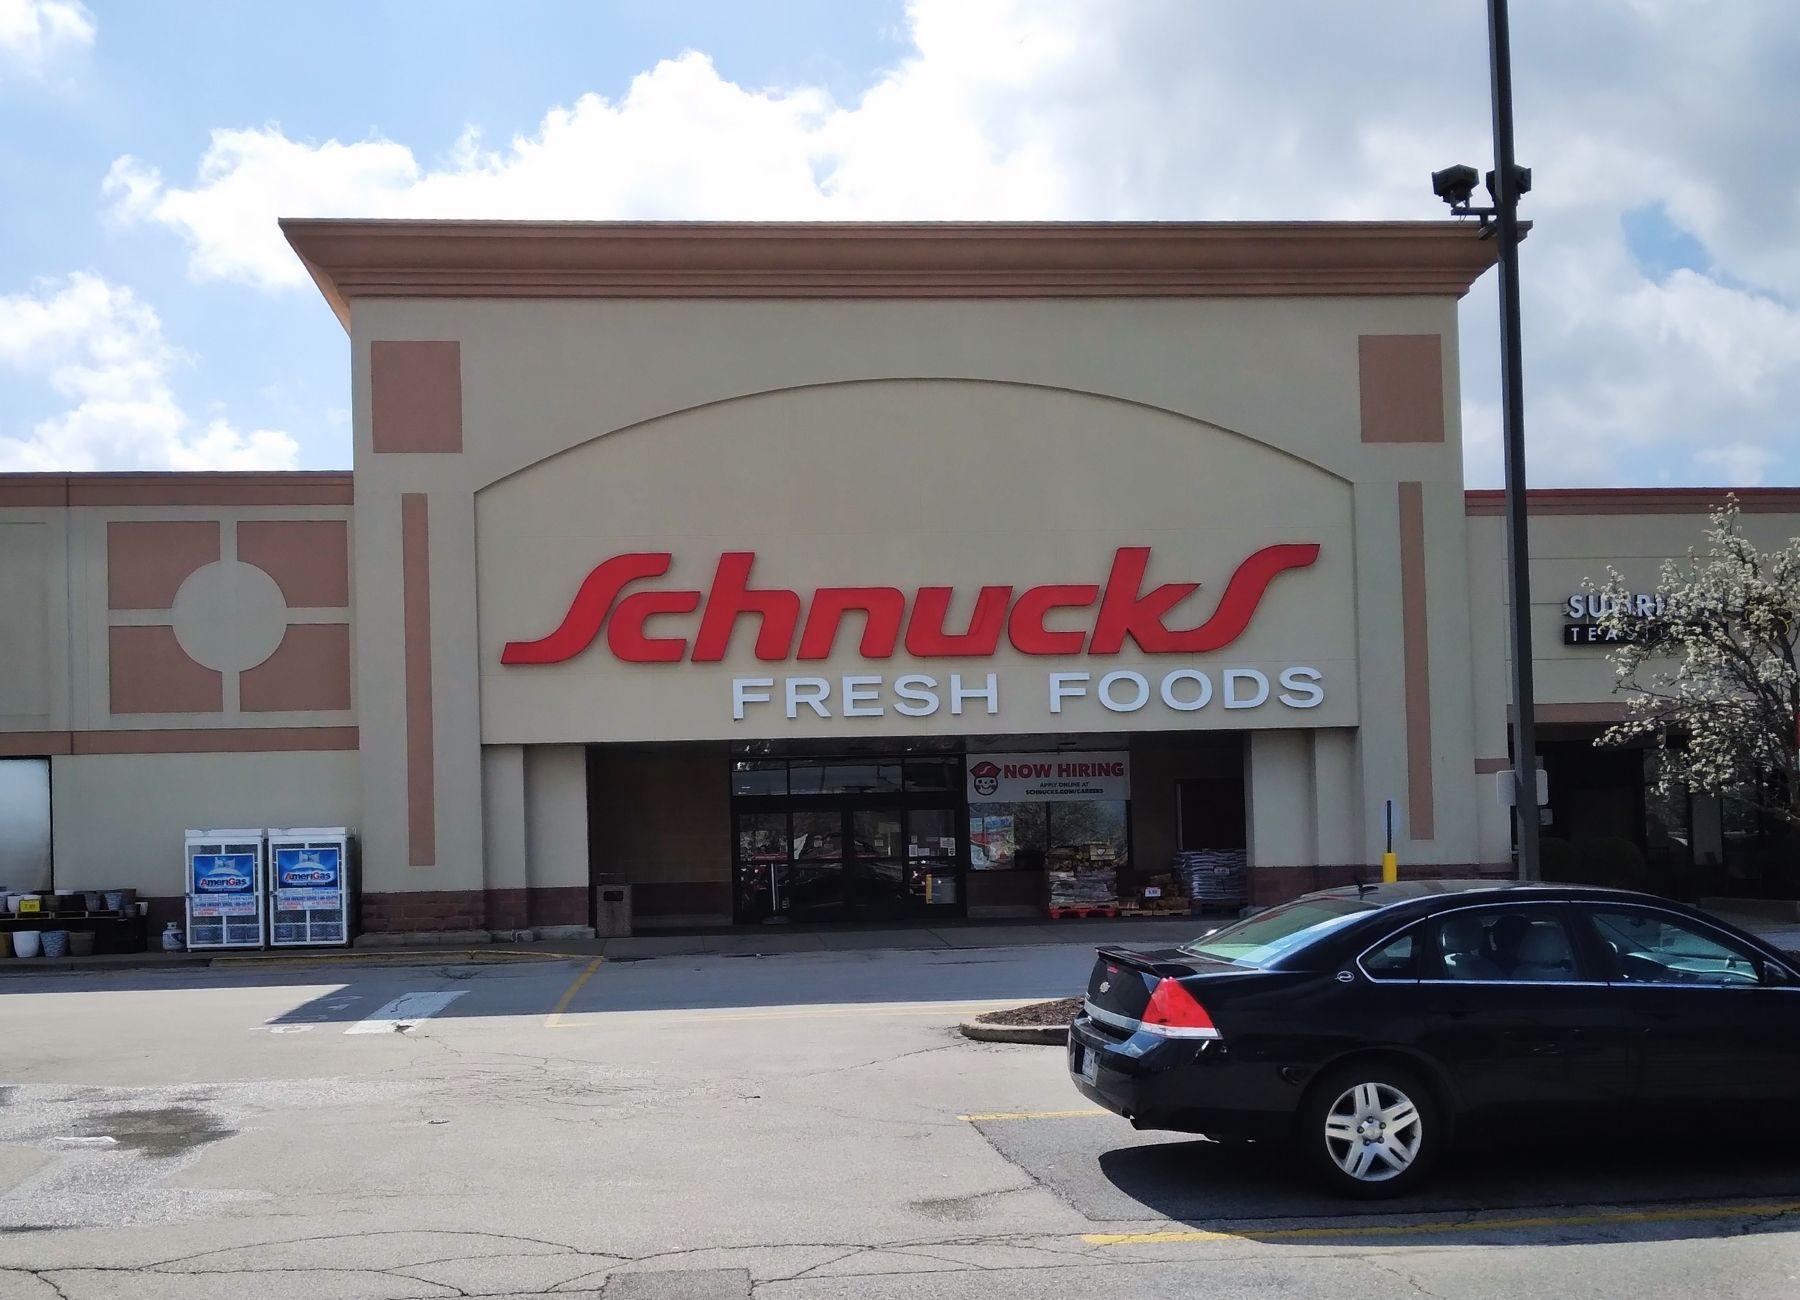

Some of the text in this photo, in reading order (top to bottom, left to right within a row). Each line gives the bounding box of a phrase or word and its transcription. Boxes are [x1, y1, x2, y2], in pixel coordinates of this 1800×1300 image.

[732, 666, 1325, 721] FRESH FOODS
[1004, 761, 1124, 779] NOW HIRING
[200, 877, 248, 888] AmeriGas
[284, 871, 332, 881] AmeriGas
